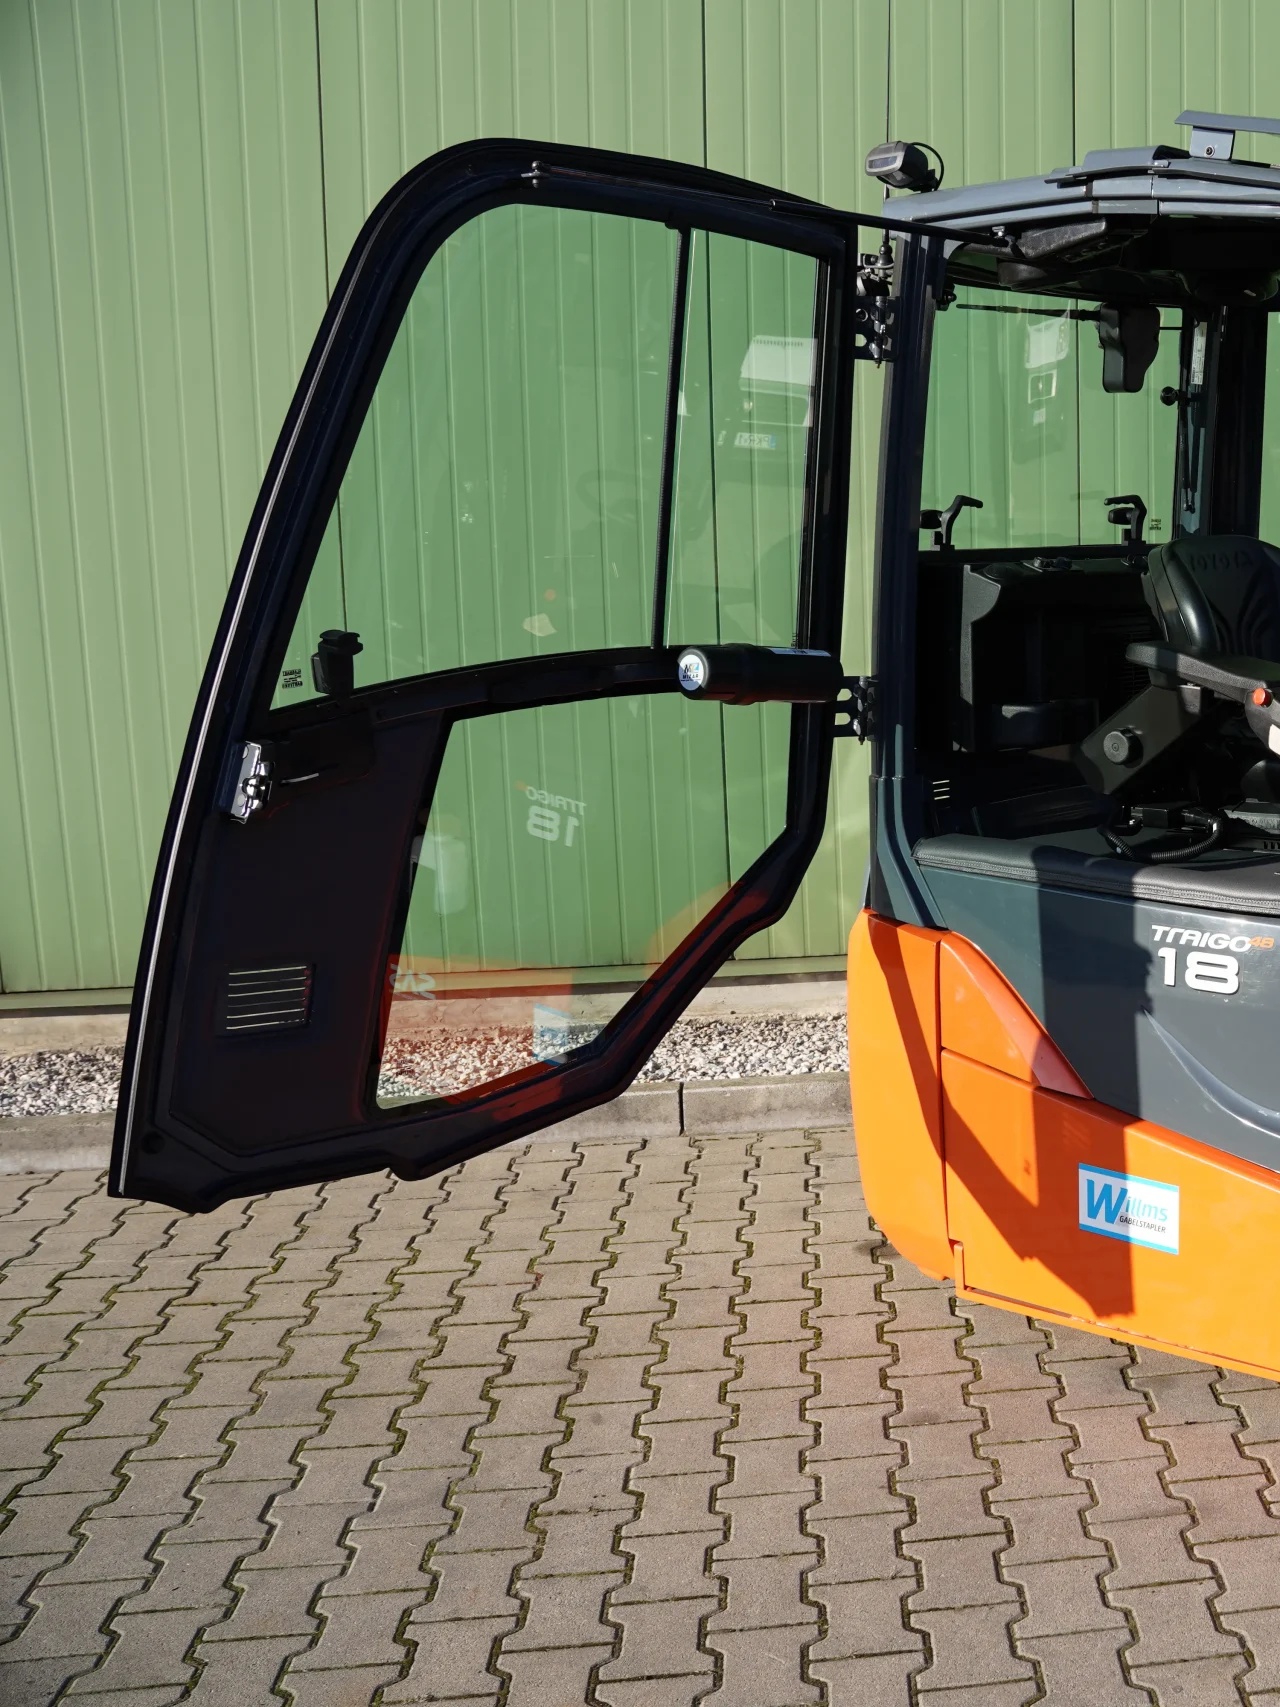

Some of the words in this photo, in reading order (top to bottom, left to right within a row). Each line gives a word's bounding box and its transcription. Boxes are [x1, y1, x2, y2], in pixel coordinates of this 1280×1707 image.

[1157, 946, 1240, 995] 18
[1086, 1178, 1168, 1224] Willms
[1119, 1214, 1166, 1233] GABELSTAPLER
